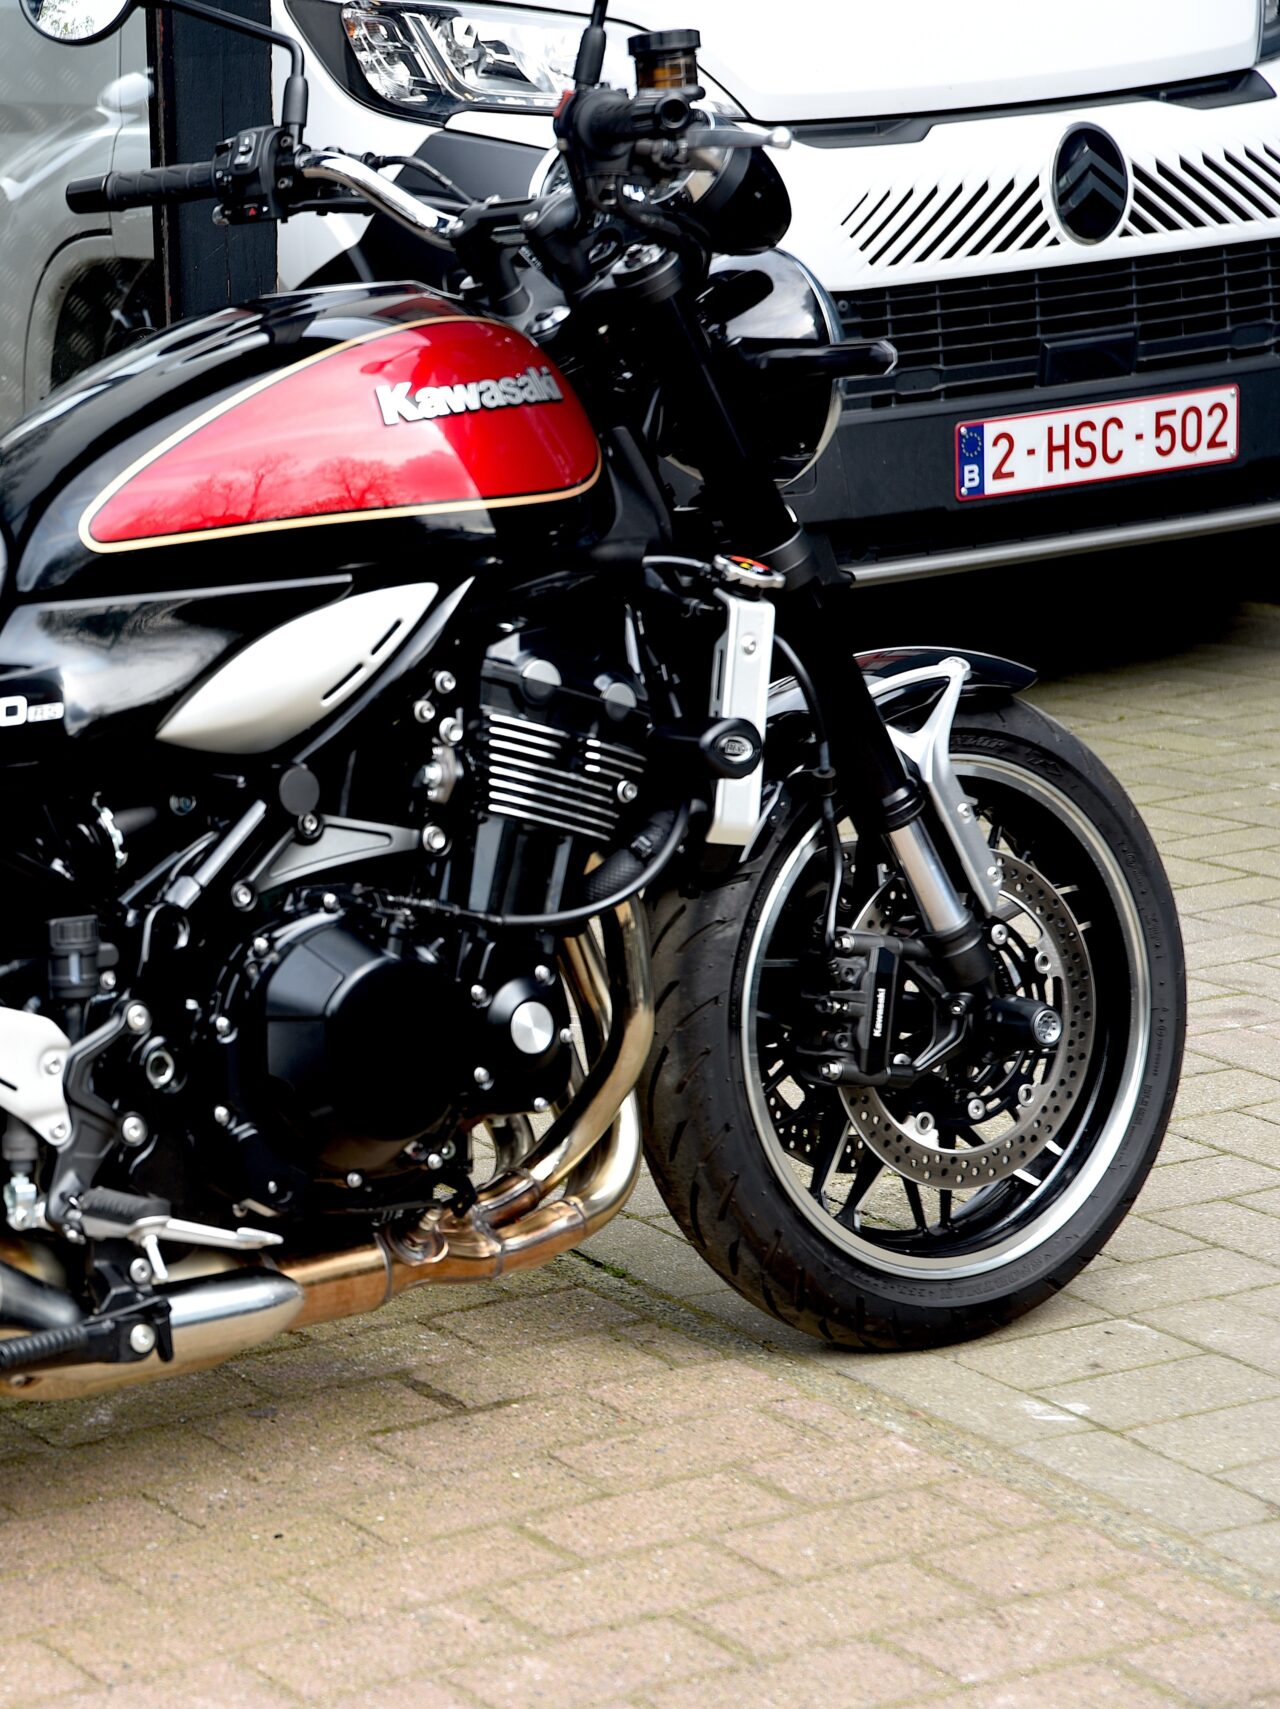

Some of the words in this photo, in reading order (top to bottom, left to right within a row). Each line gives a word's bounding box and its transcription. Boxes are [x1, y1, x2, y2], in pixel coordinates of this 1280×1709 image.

[375, 366, 564, 426] Kawasaki
[963, 464, 980, 489] B
[873, 987, 887, 1038] Kawasaki
